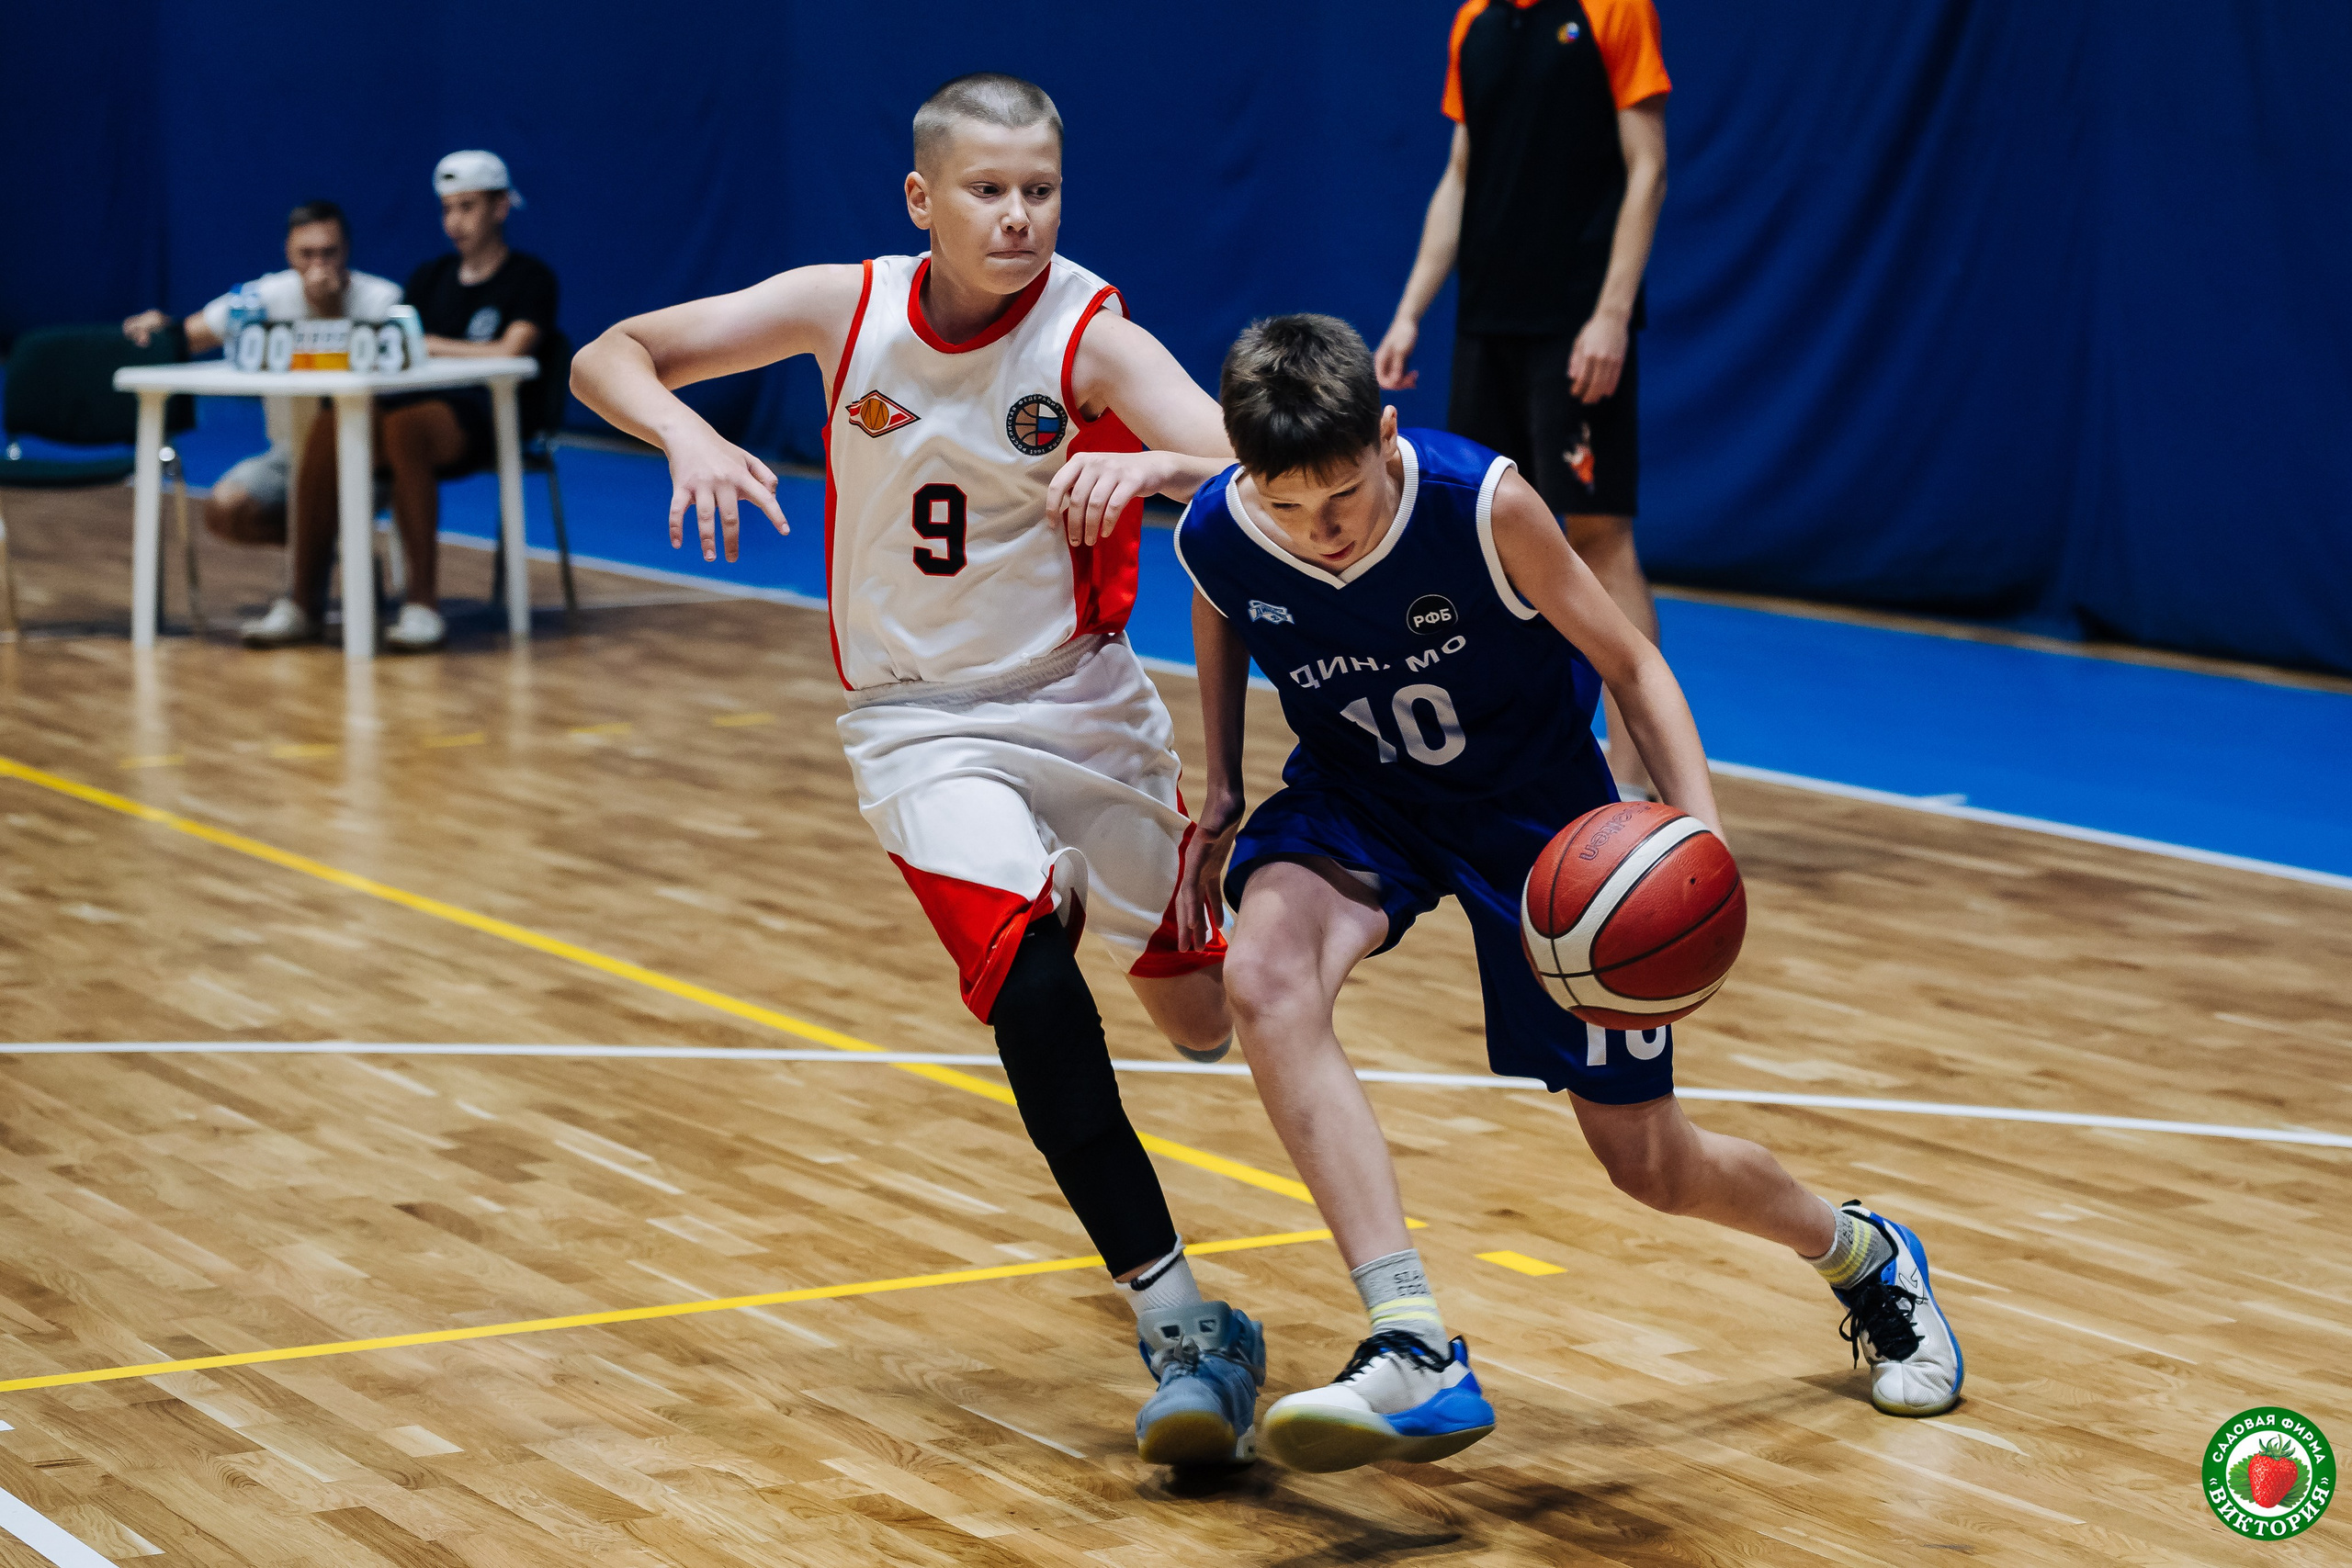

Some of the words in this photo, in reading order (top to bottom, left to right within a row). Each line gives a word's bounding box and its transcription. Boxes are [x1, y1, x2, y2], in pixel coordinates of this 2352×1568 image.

[912, 483, 967, 577] 9
[1413, 608, 1452, 627] РФБ
[1289, 635, 1466, 689] ДИНМО
[1340, 684, 1466, 766] 10
